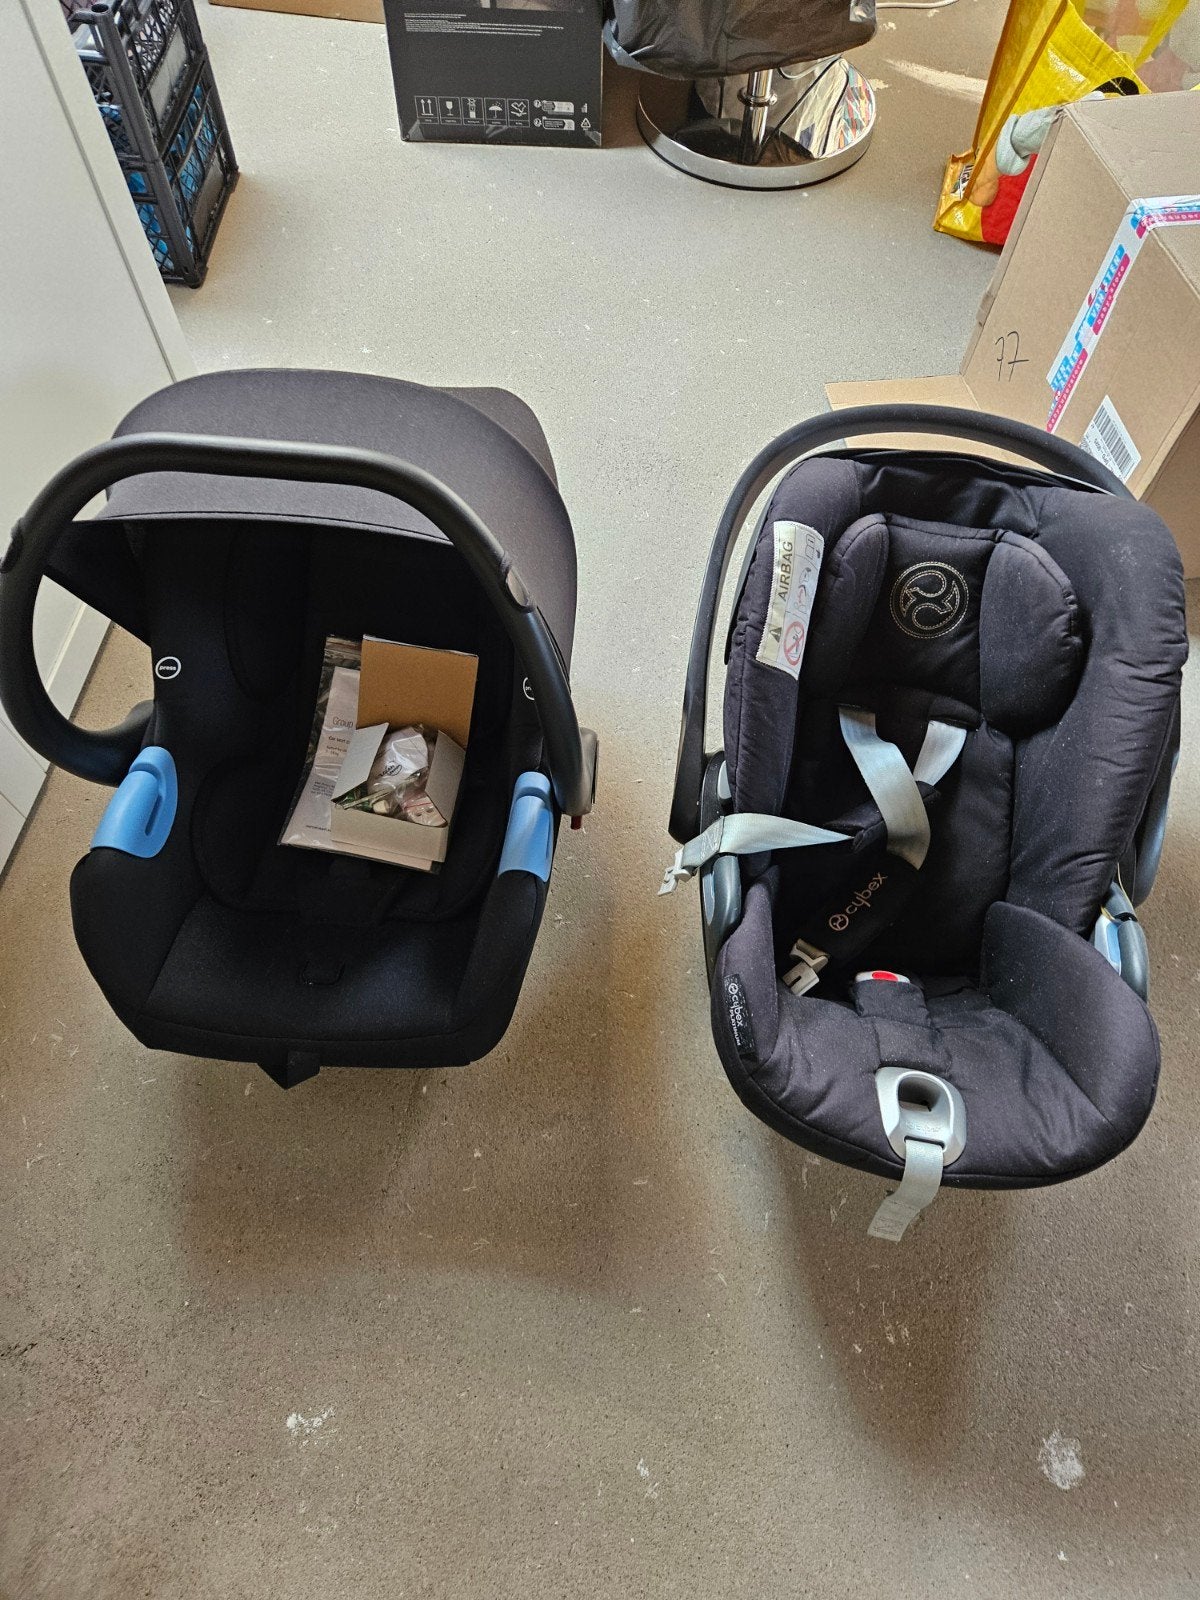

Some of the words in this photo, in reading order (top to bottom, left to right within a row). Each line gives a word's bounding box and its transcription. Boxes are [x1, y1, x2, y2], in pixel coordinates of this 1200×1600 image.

[994, 331, 1030, 382] 77
[778, 541, 793, 601] AIRBAG
[845, 872, 888, 914] cybex
[731, 994, 743, 1027] cybex
